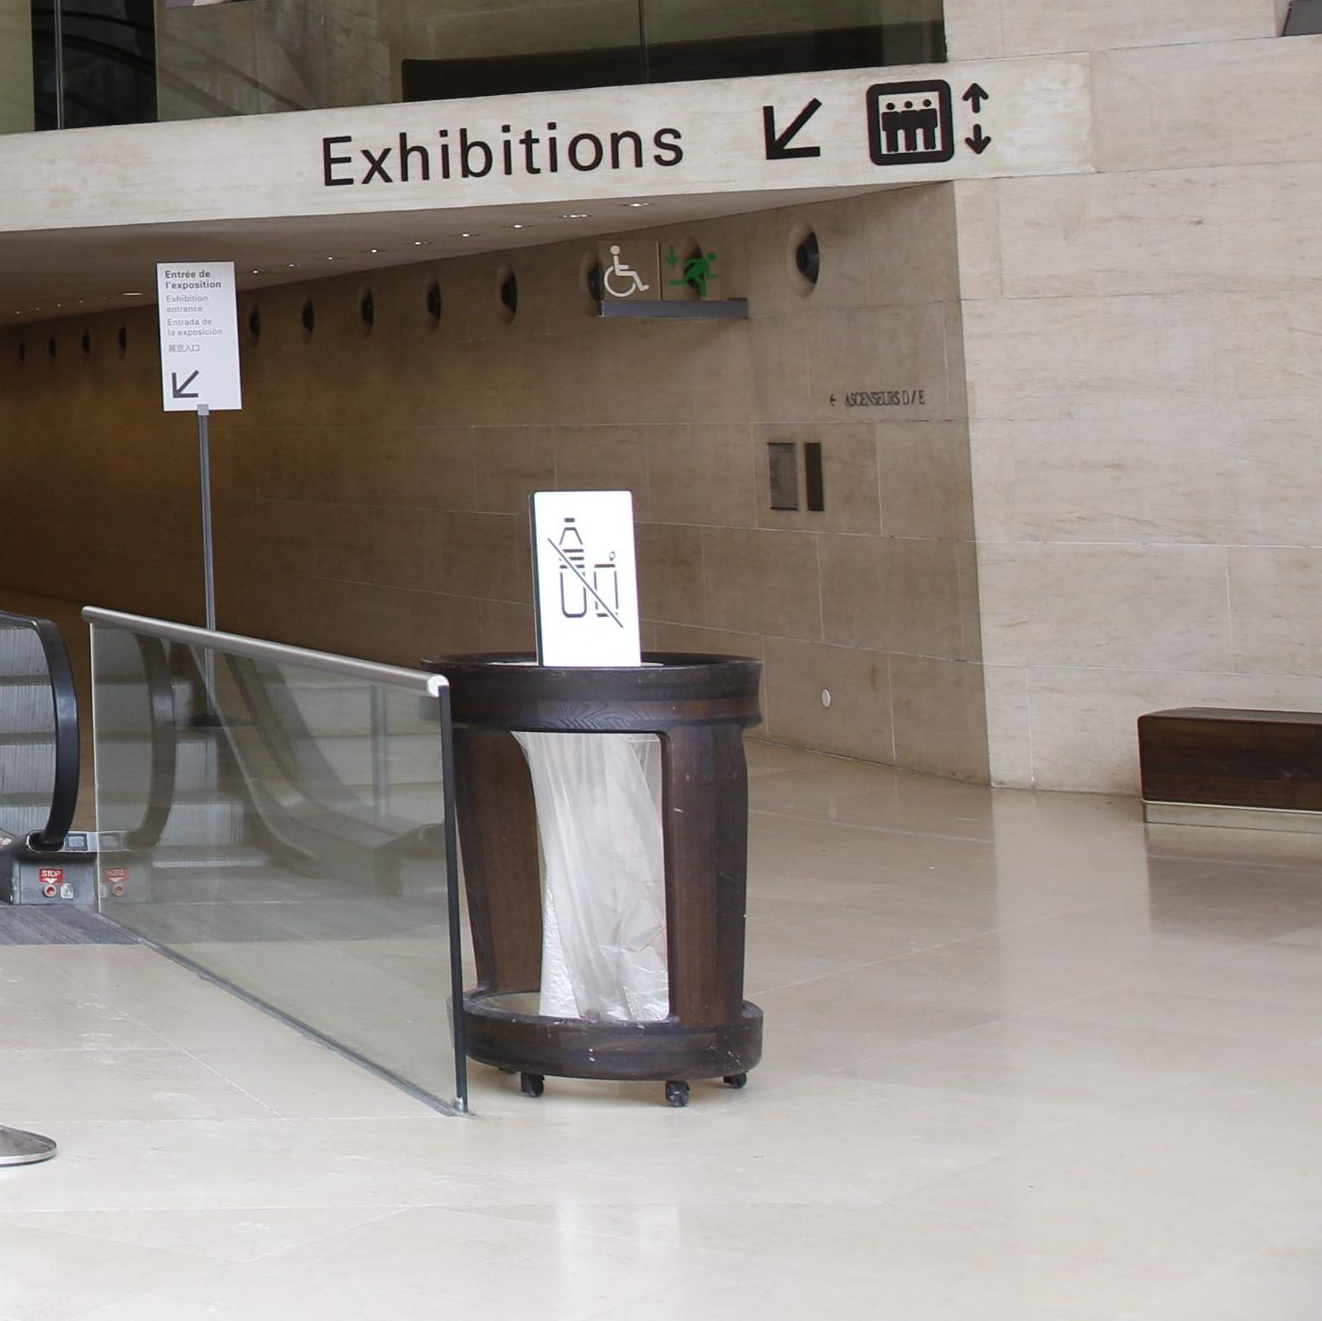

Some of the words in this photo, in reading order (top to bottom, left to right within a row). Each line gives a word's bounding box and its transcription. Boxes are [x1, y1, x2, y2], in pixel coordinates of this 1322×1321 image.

[322, 122, 684, 187] Exhibitions
[165, 270, 196, 278] Entrée
[199, 270, 211, 278] de
[165, 281, 222, 290] l'exposition
[166, 295, 209, 303] Exhibition
[167, 318, 200, 326] Entrada
[202, 318, 213, 326] de
[41, 870, 61, 878] STOP
